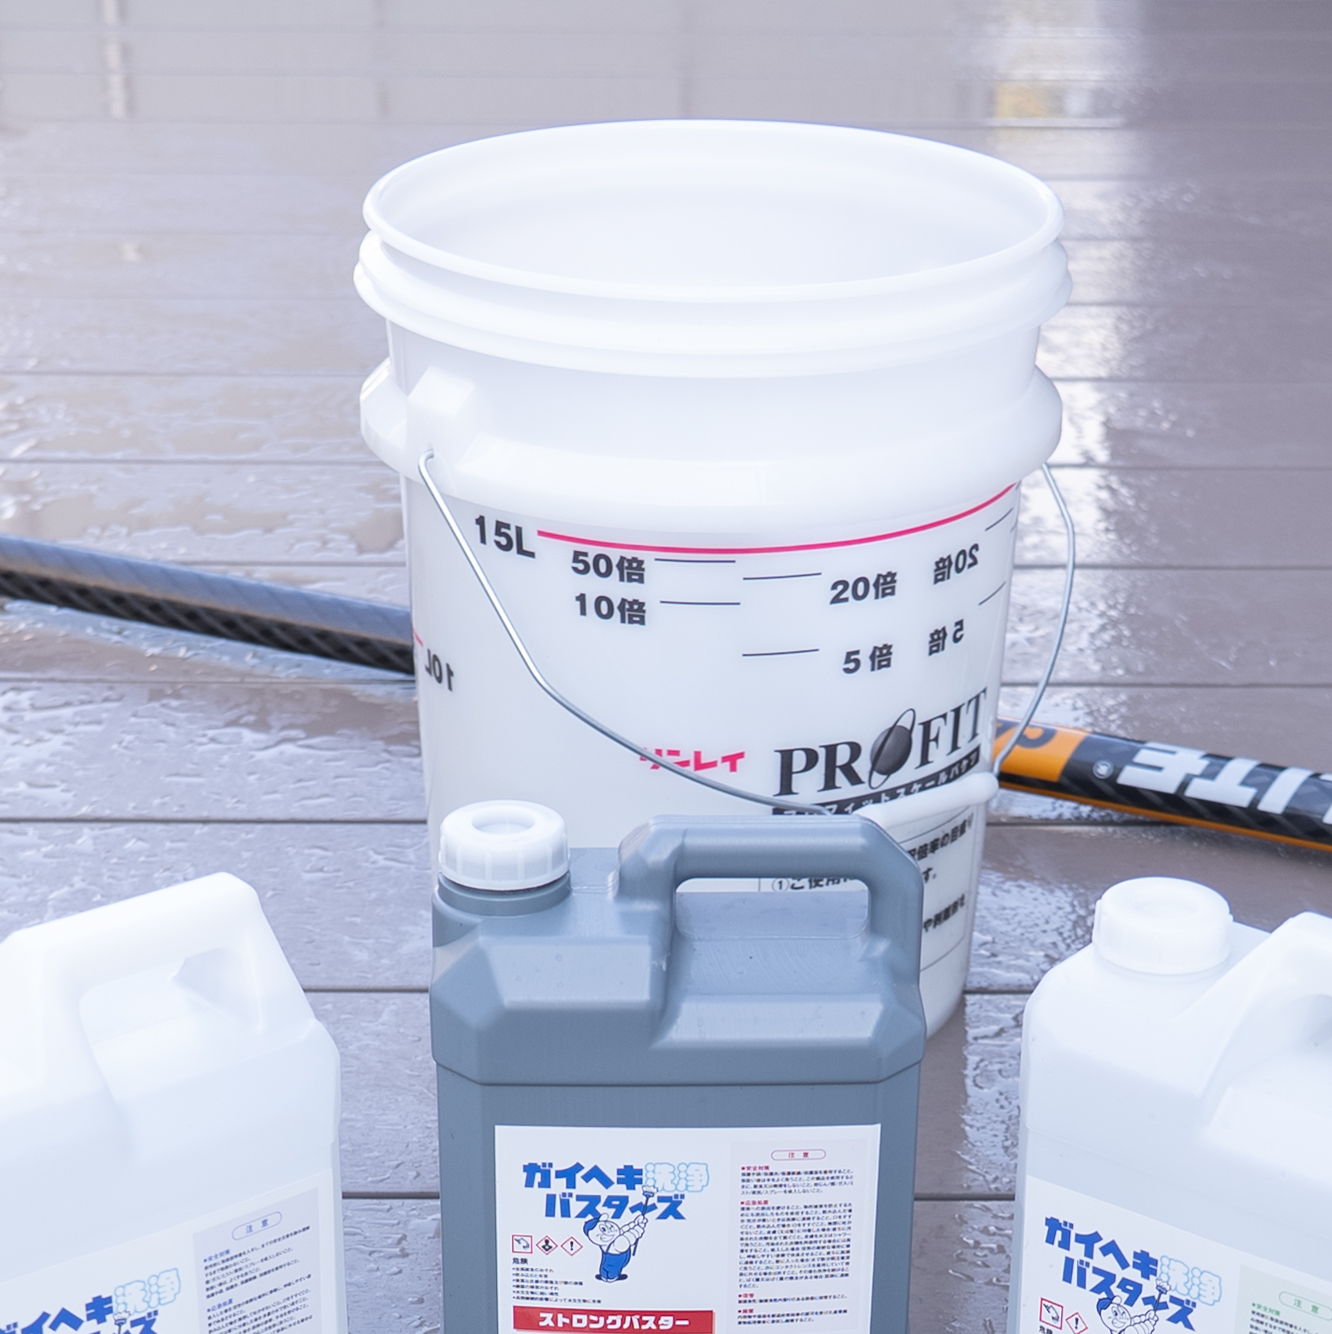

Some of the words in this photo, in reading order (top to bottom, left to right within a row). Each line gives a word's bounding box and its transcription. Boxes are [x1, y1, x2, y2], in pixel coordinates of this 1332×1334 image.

[474, 514, 536, 560] 15L
[570, 550, 646, 585] 50倍
[829, 571, 898, 606] 20倍
[574, 592, 647, 627] 10倍
[773, 687, 987, 797] PROFIT
[783, 755, 979, 815] フィットスケールバケツ
[538, 1312, 689, 1330] ストロングバスター
